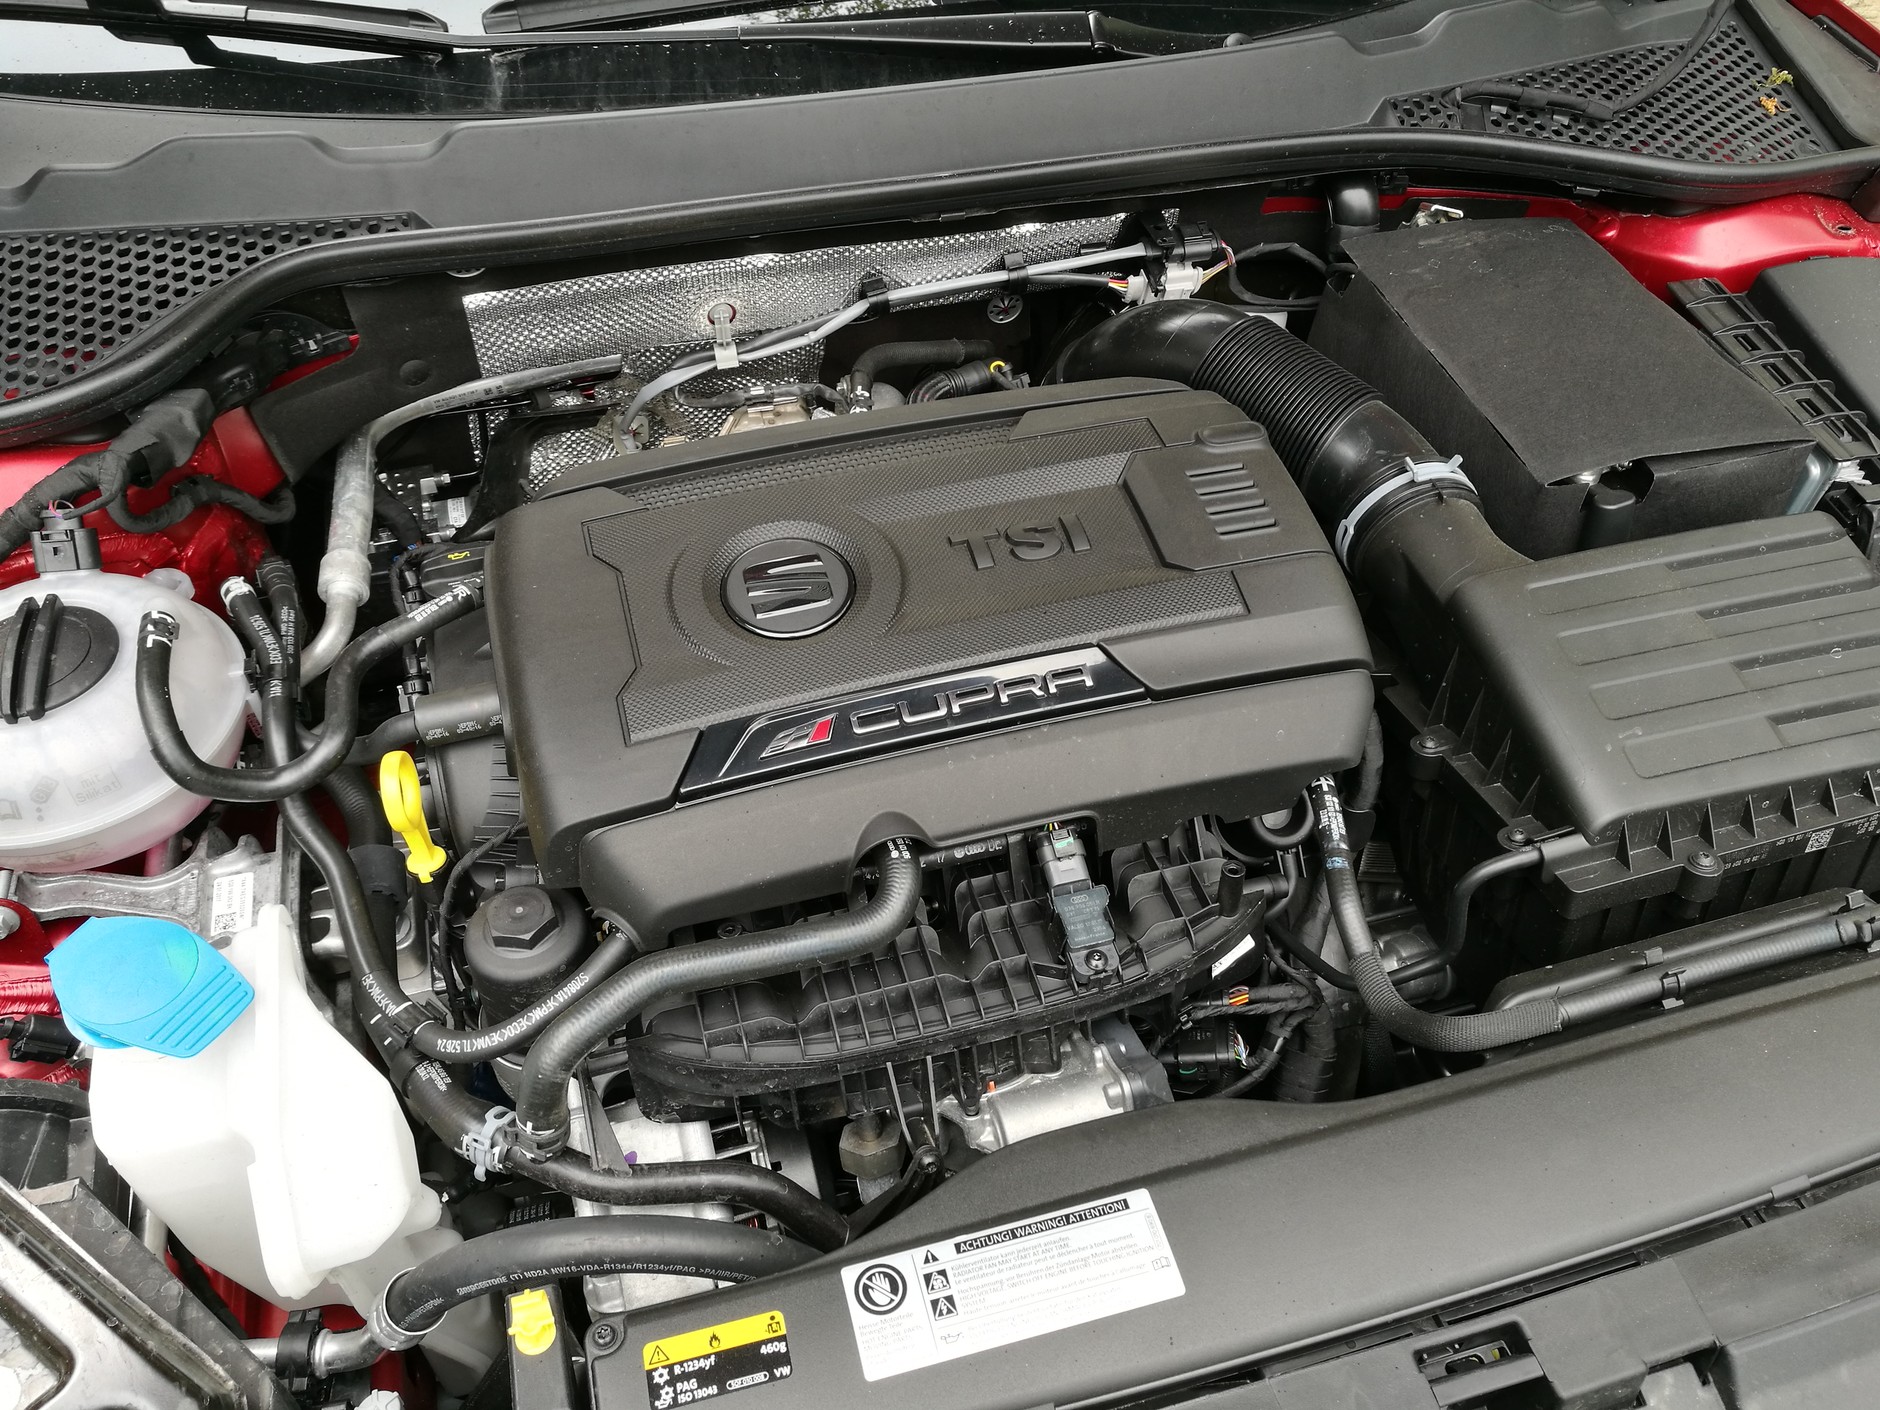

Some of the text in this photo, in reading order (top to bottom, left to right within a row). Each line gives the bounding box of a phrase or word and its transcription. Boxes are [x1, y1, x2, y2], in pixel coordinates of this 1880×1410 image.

[949, 514, 1092, 571] TSI
[850, 662, 1095, 736] CUPRA
[74, 783, 120, 806] Silikat
[958, 1199, 1127, 1252] ACHTUNG! WARNING! ATTENTION!
[950, 1253, 1000, 1271] Kühlerventilator
[1000, 1249, 1016, 1258] kann
[952, 1265, 984, 1278] RADIATOR
[983, 1261, 997, 1269] FAN
[997, 1257, 1012, 1266] MAY
[1015, 1252, 1031, 1261] START
[1040, 1246, 1054, 1255] ANY
[961, 1269, 996, 1283] ventilateur
[1004, 1258, 1033, 1271] radiateur
[1094, 1238, 1109, 1247] tout
[456, 1275, 508, 1296] BRIDGESTONE
[509, 1272, 523, 1282] (T)
[523, 1265, 549, 1280] ND2A
[759, 1339, 788, 1358] 460g
[672, 1354, 717, 1376] R-1234yf
[773, 1365, 791, 1378] VW
[675, 1378, 698, 1393] PAG
[676, 1384, 718, 1403] ISO 13043
